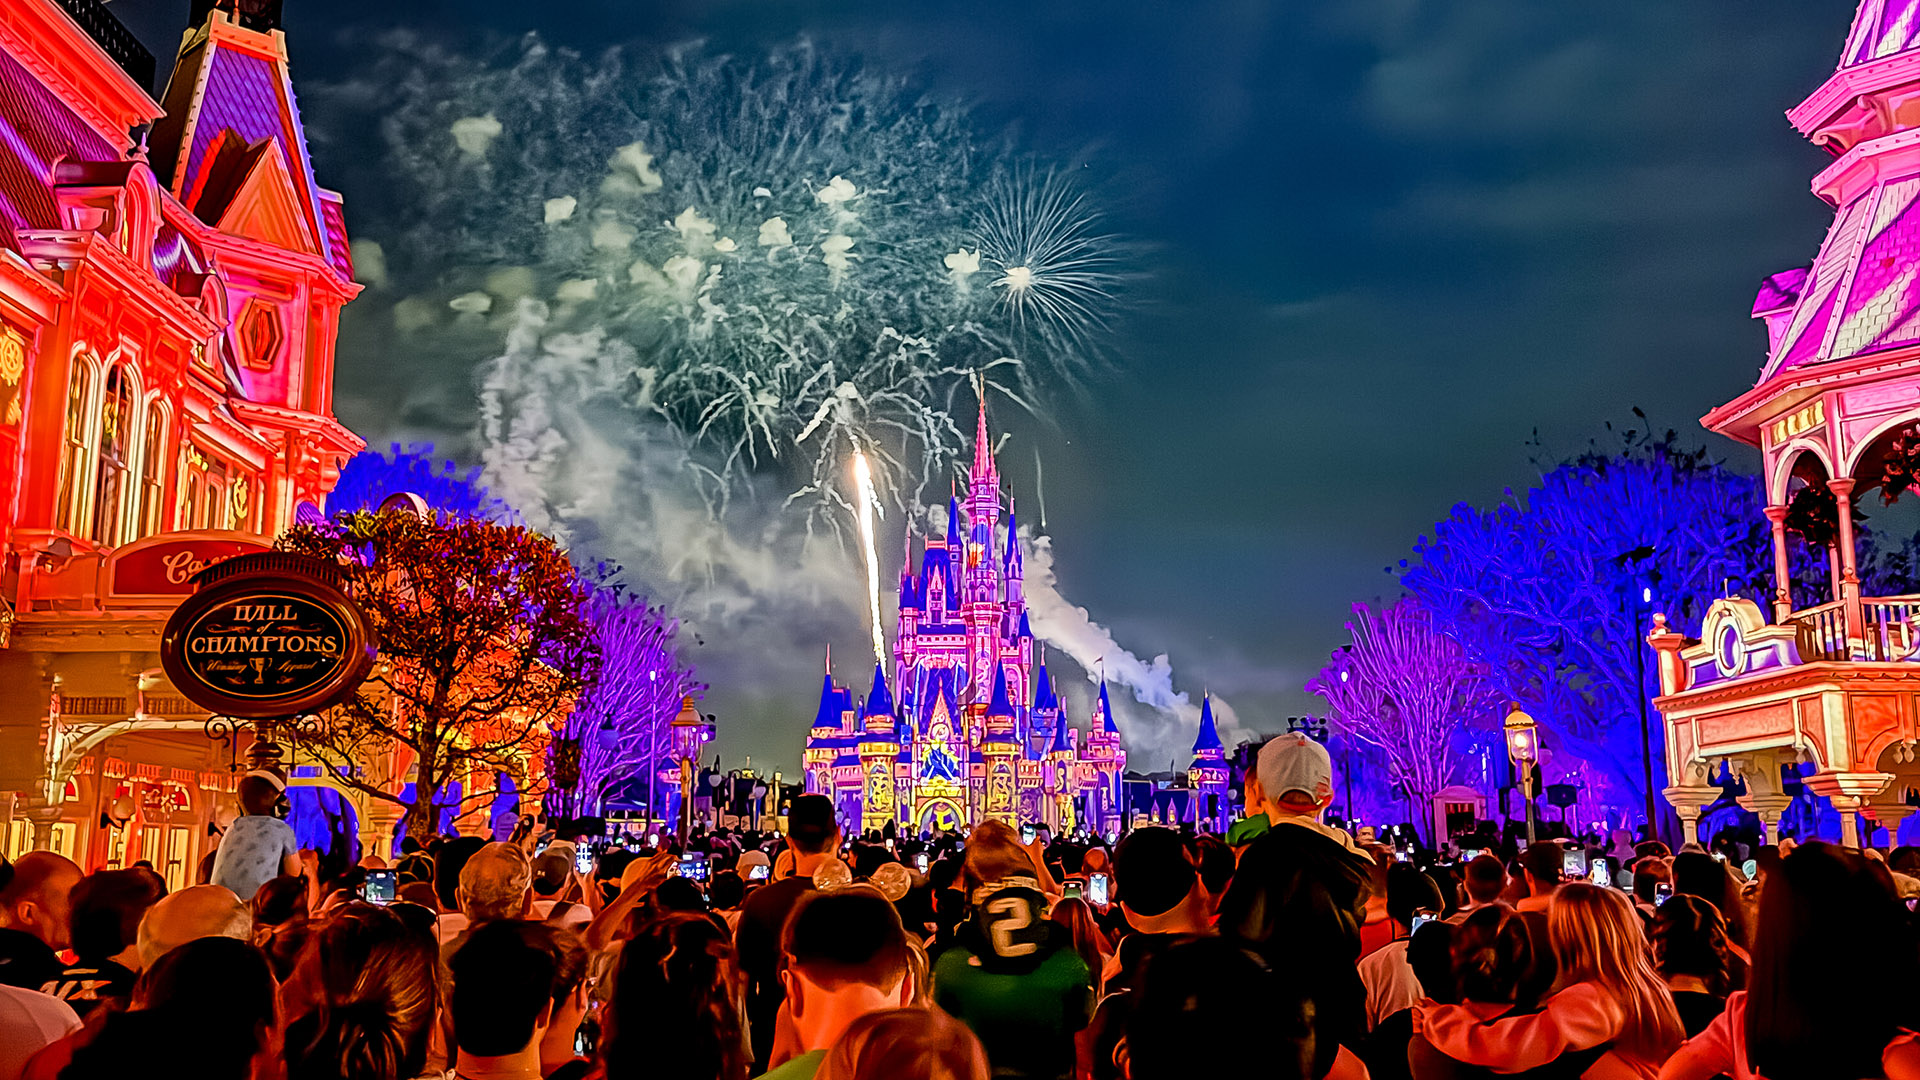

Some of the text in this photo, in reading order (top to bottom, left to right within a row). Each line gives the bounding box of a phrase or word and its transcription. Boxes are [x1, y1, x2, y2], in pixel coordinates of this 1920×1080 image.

[233, 605, 298, 622] HALL
[256, 621, 275, 635] of
[191, 636, 337, 654] CHAMPIONS
[987, 897, 1037, 957] 2
